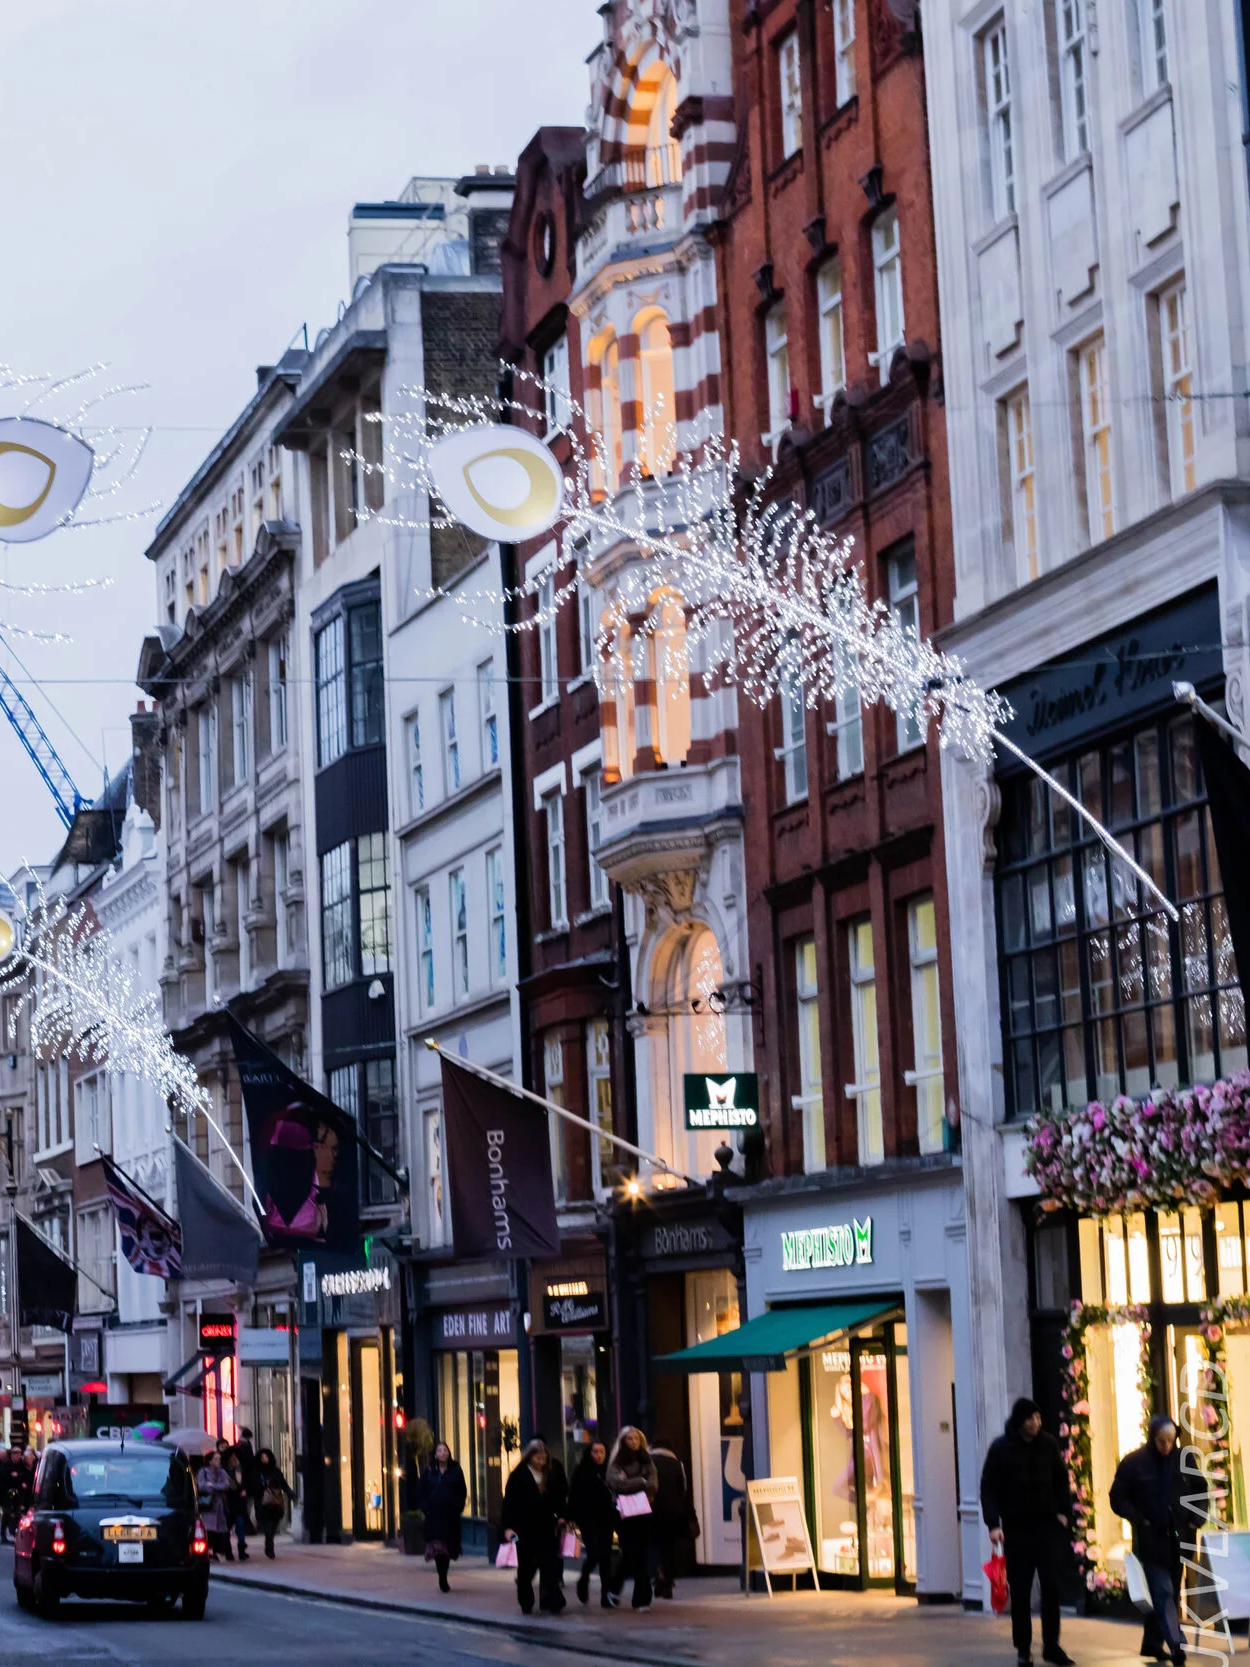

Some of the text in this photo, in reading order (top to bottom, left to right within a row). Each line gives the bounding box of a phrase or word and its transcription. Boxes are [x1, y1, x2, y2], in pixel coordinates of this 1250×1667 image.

[689, 1108, 757, 1126] MEPHISTO
[487, 1129, 512, 1250] Bonhams
[655, 1223, 708, 1255] Bonhams
[781, 1223, 855, 1271] MEPHISTO
[443, 1311, 511, 1338] EDEN FINE ART
